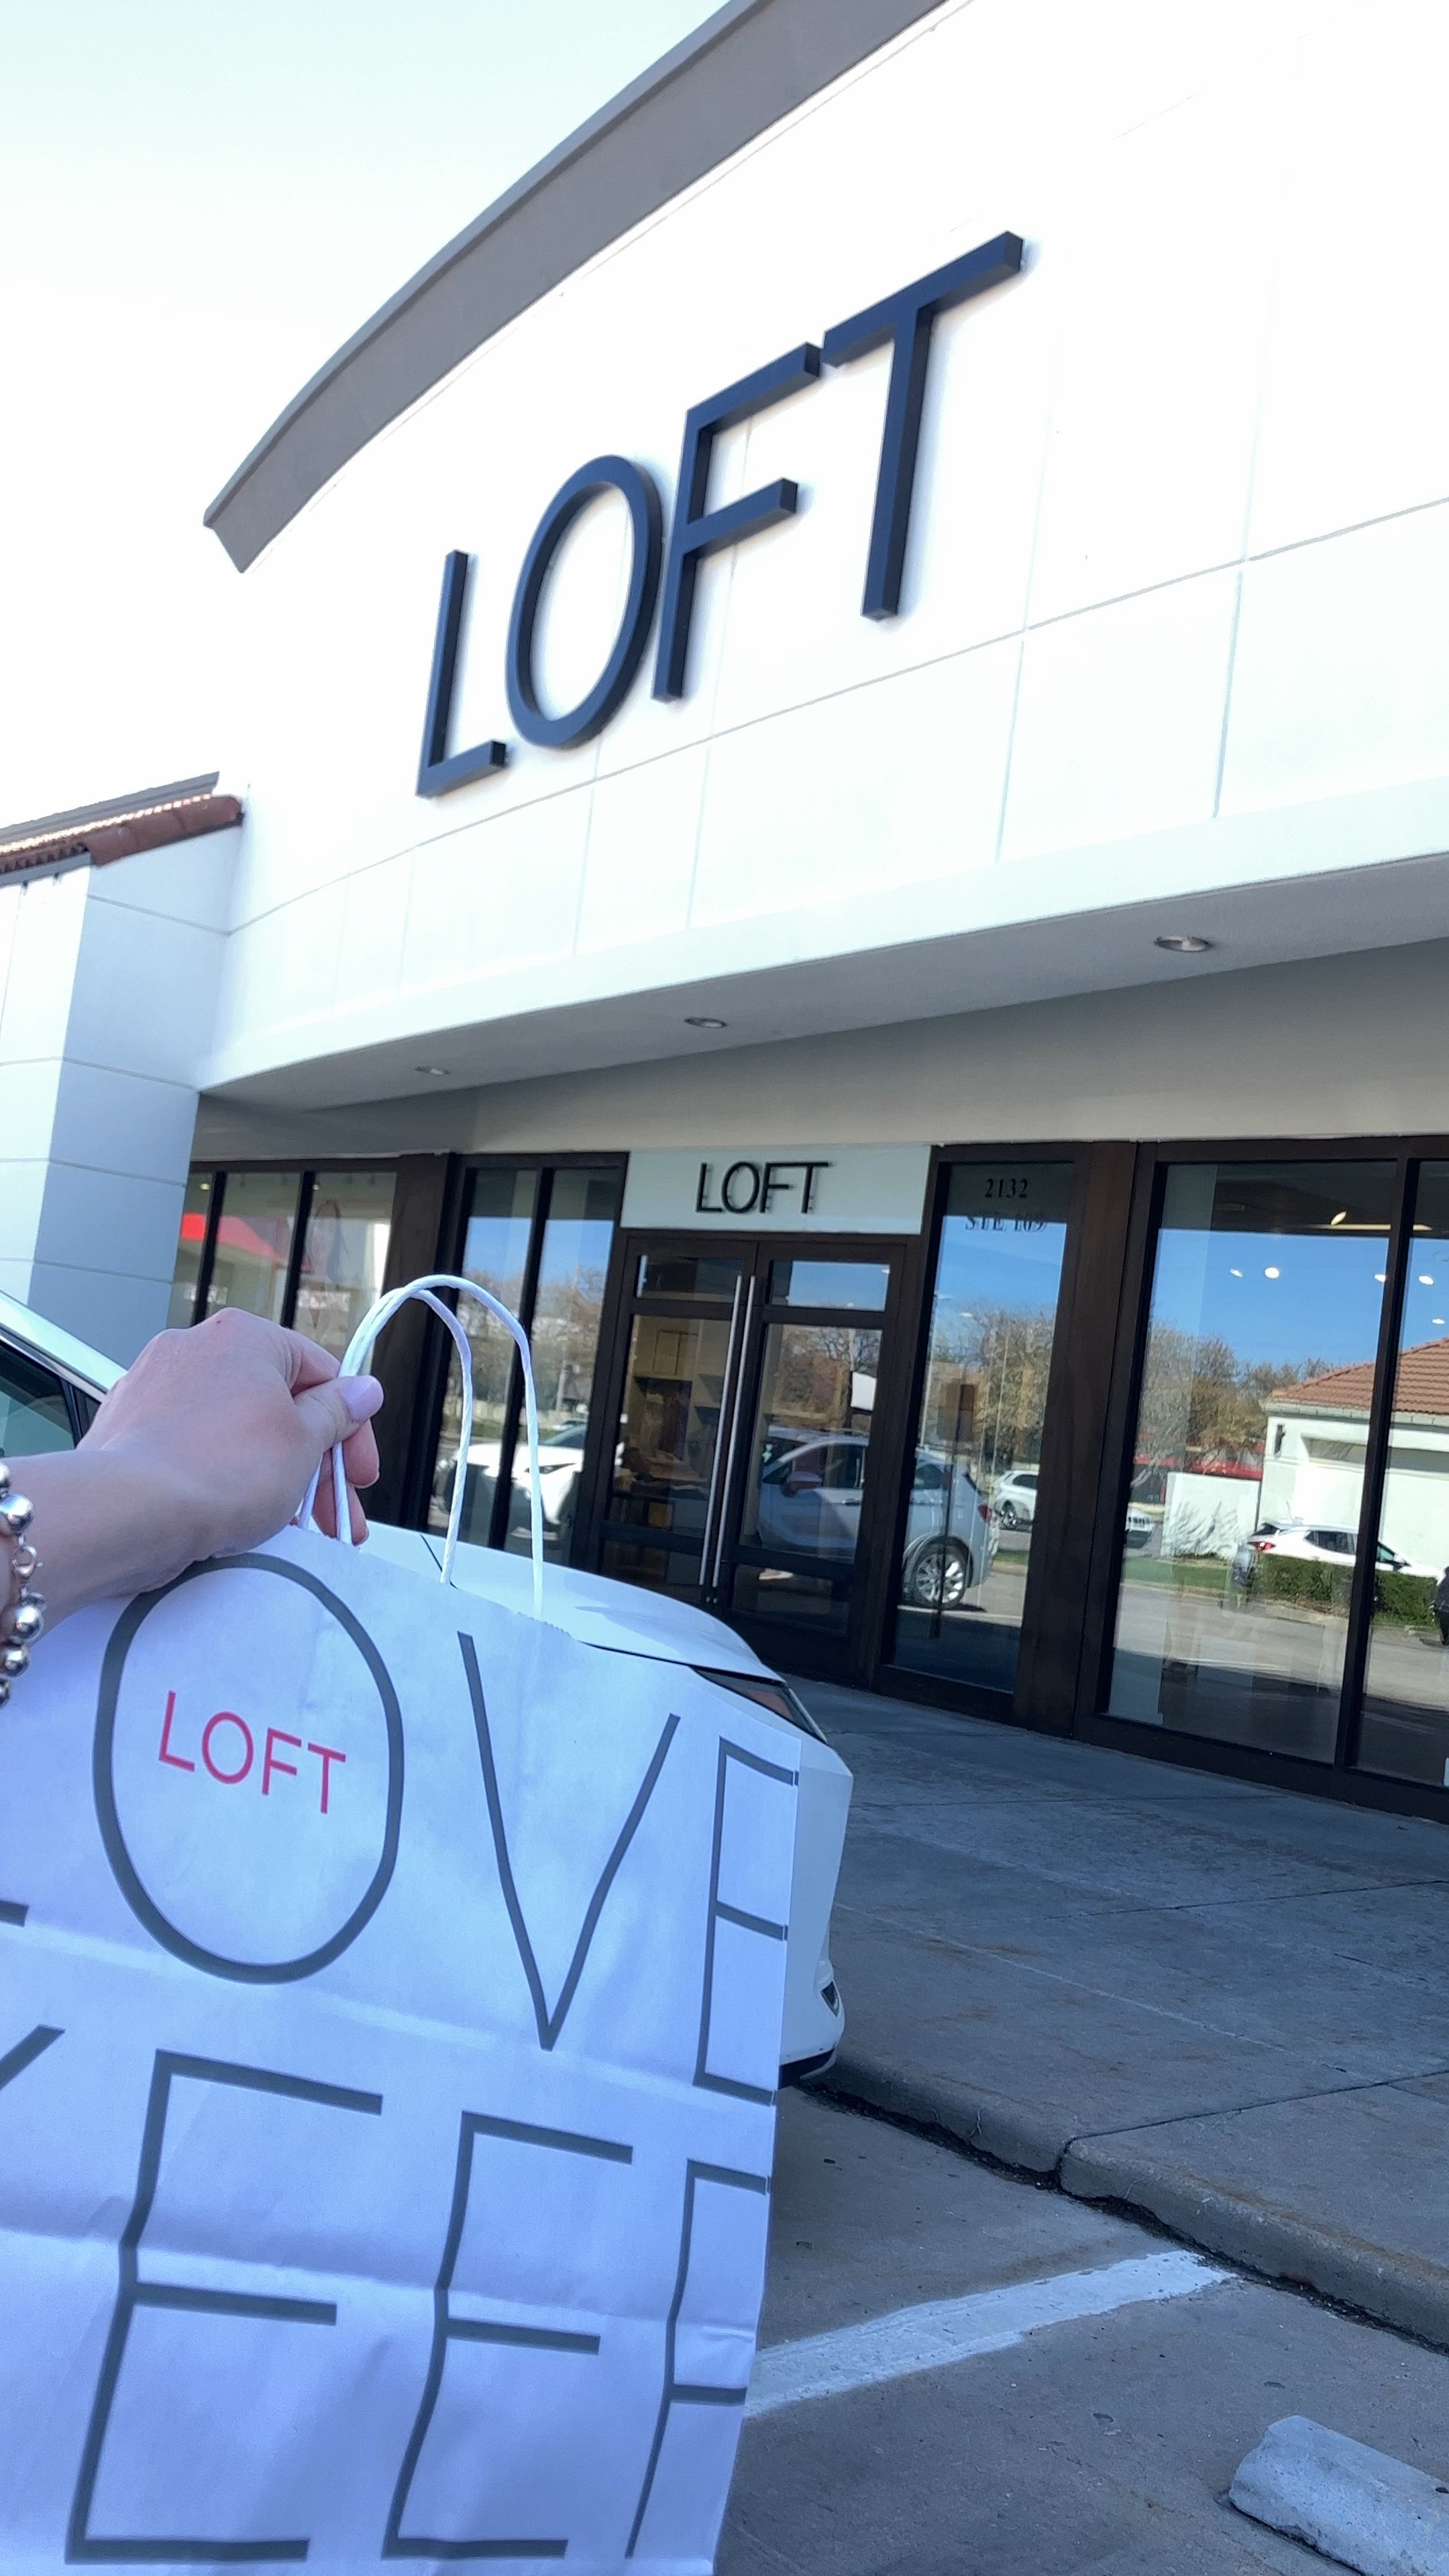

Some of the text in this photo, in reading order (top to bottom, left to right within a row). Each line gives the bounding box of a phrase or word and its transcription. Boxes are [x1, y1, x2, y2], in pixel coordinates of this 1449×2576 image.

[416, 231, 1024, 798] LOFT
[695, 1161, 830, 1214] LOFT
[984, 1177, 1029, 1198] 2132
[159, 1690, 346, 1814] LOFT
[0, 1552, 799, 2106] OVE
